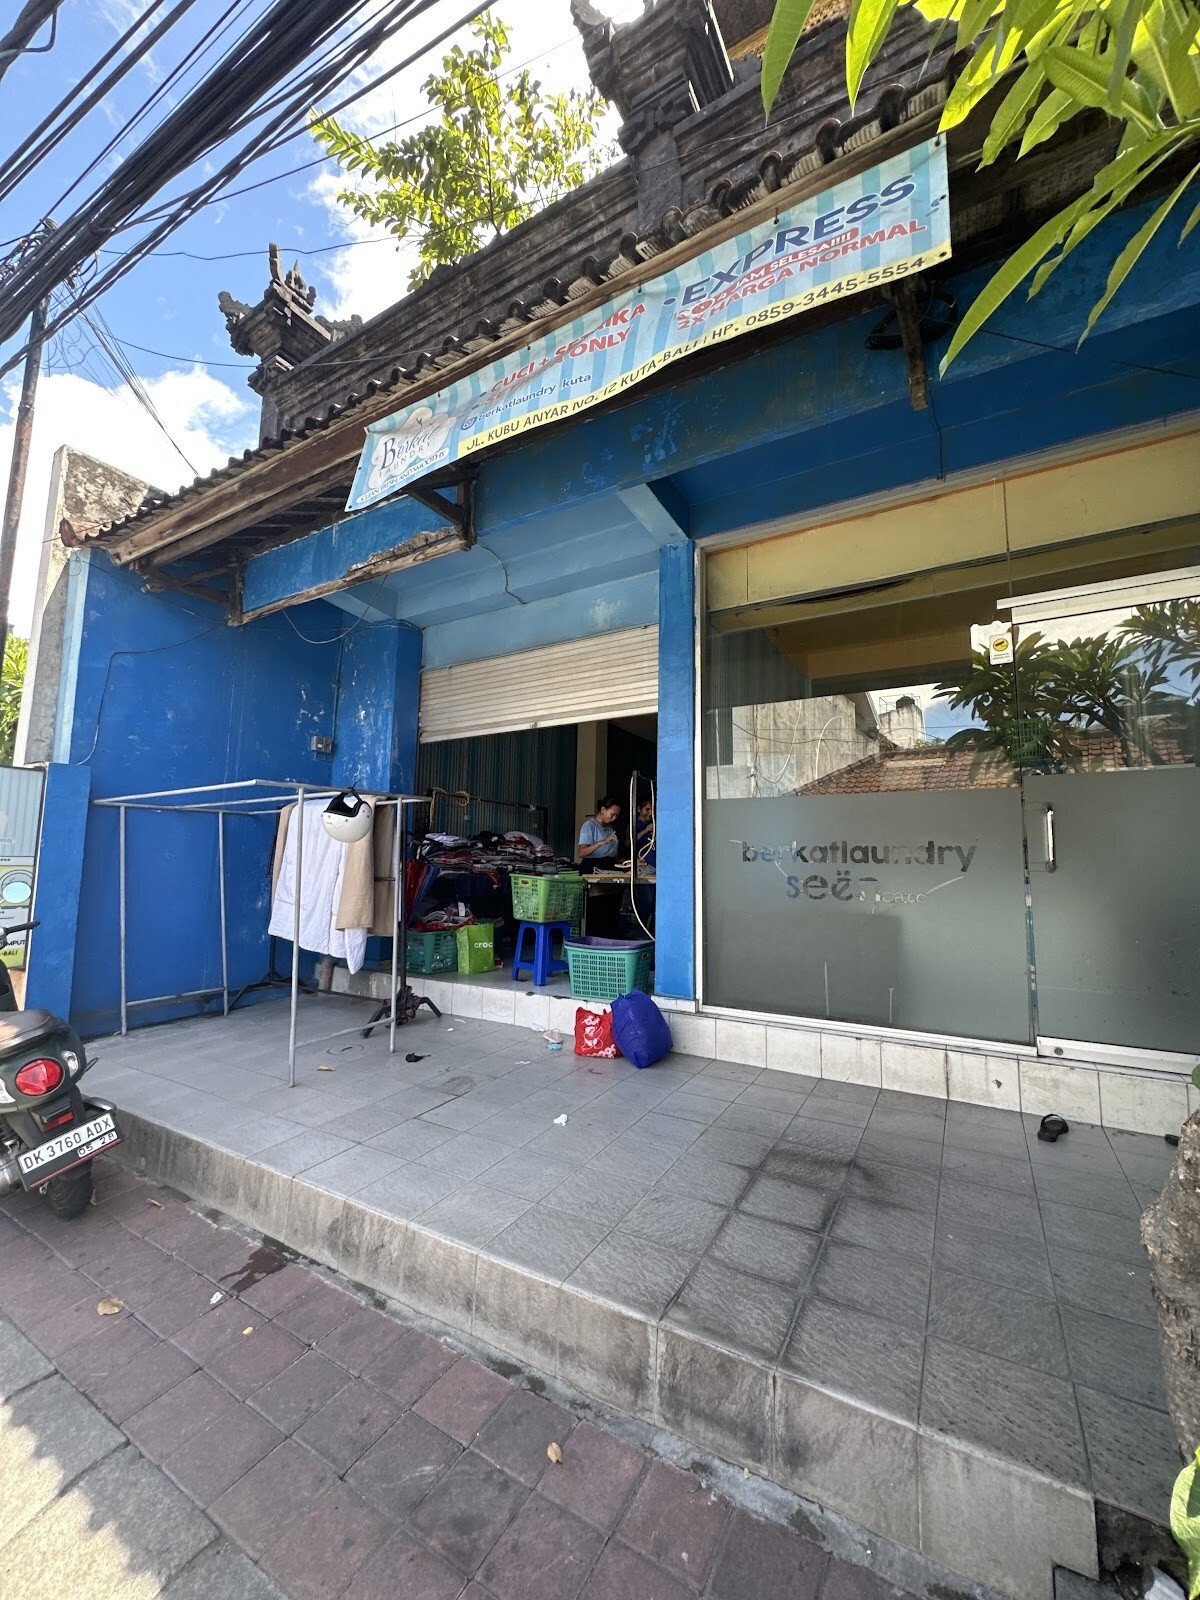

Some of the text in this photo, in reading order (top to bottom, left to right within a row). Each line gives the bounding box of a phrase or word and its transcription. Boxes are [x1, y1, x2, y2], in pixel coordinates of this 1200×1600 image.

[682, 174, 915, 306] EXPRESS
[710, 268, 794, 316] HARGA
[799, 220, 927, 273] NORMAL
[732, 267, 765, 292] JAM
[466, 437, 485, 451] JL.
[487, 420, 520, 442] KUBU
[523, 405, 569, 428] ANYAR
[572, 395, 599, 411] NO.
[603, 382, 617, 397] 12
[620, 344, 698, 387] KUTA-BALI
[712, 323, 739, 340] HP.
[746, 256, 926, 326] 0859-3445-5554
[569, 326, 631, 358] ONLY
[491, 362, 535, 393] CUCI
[380, 420, 442, 470] Berkat
[742, 840, 977, 872] berkatlaundry
[23, 1117, 112, 1170] DK 3760 ADX
